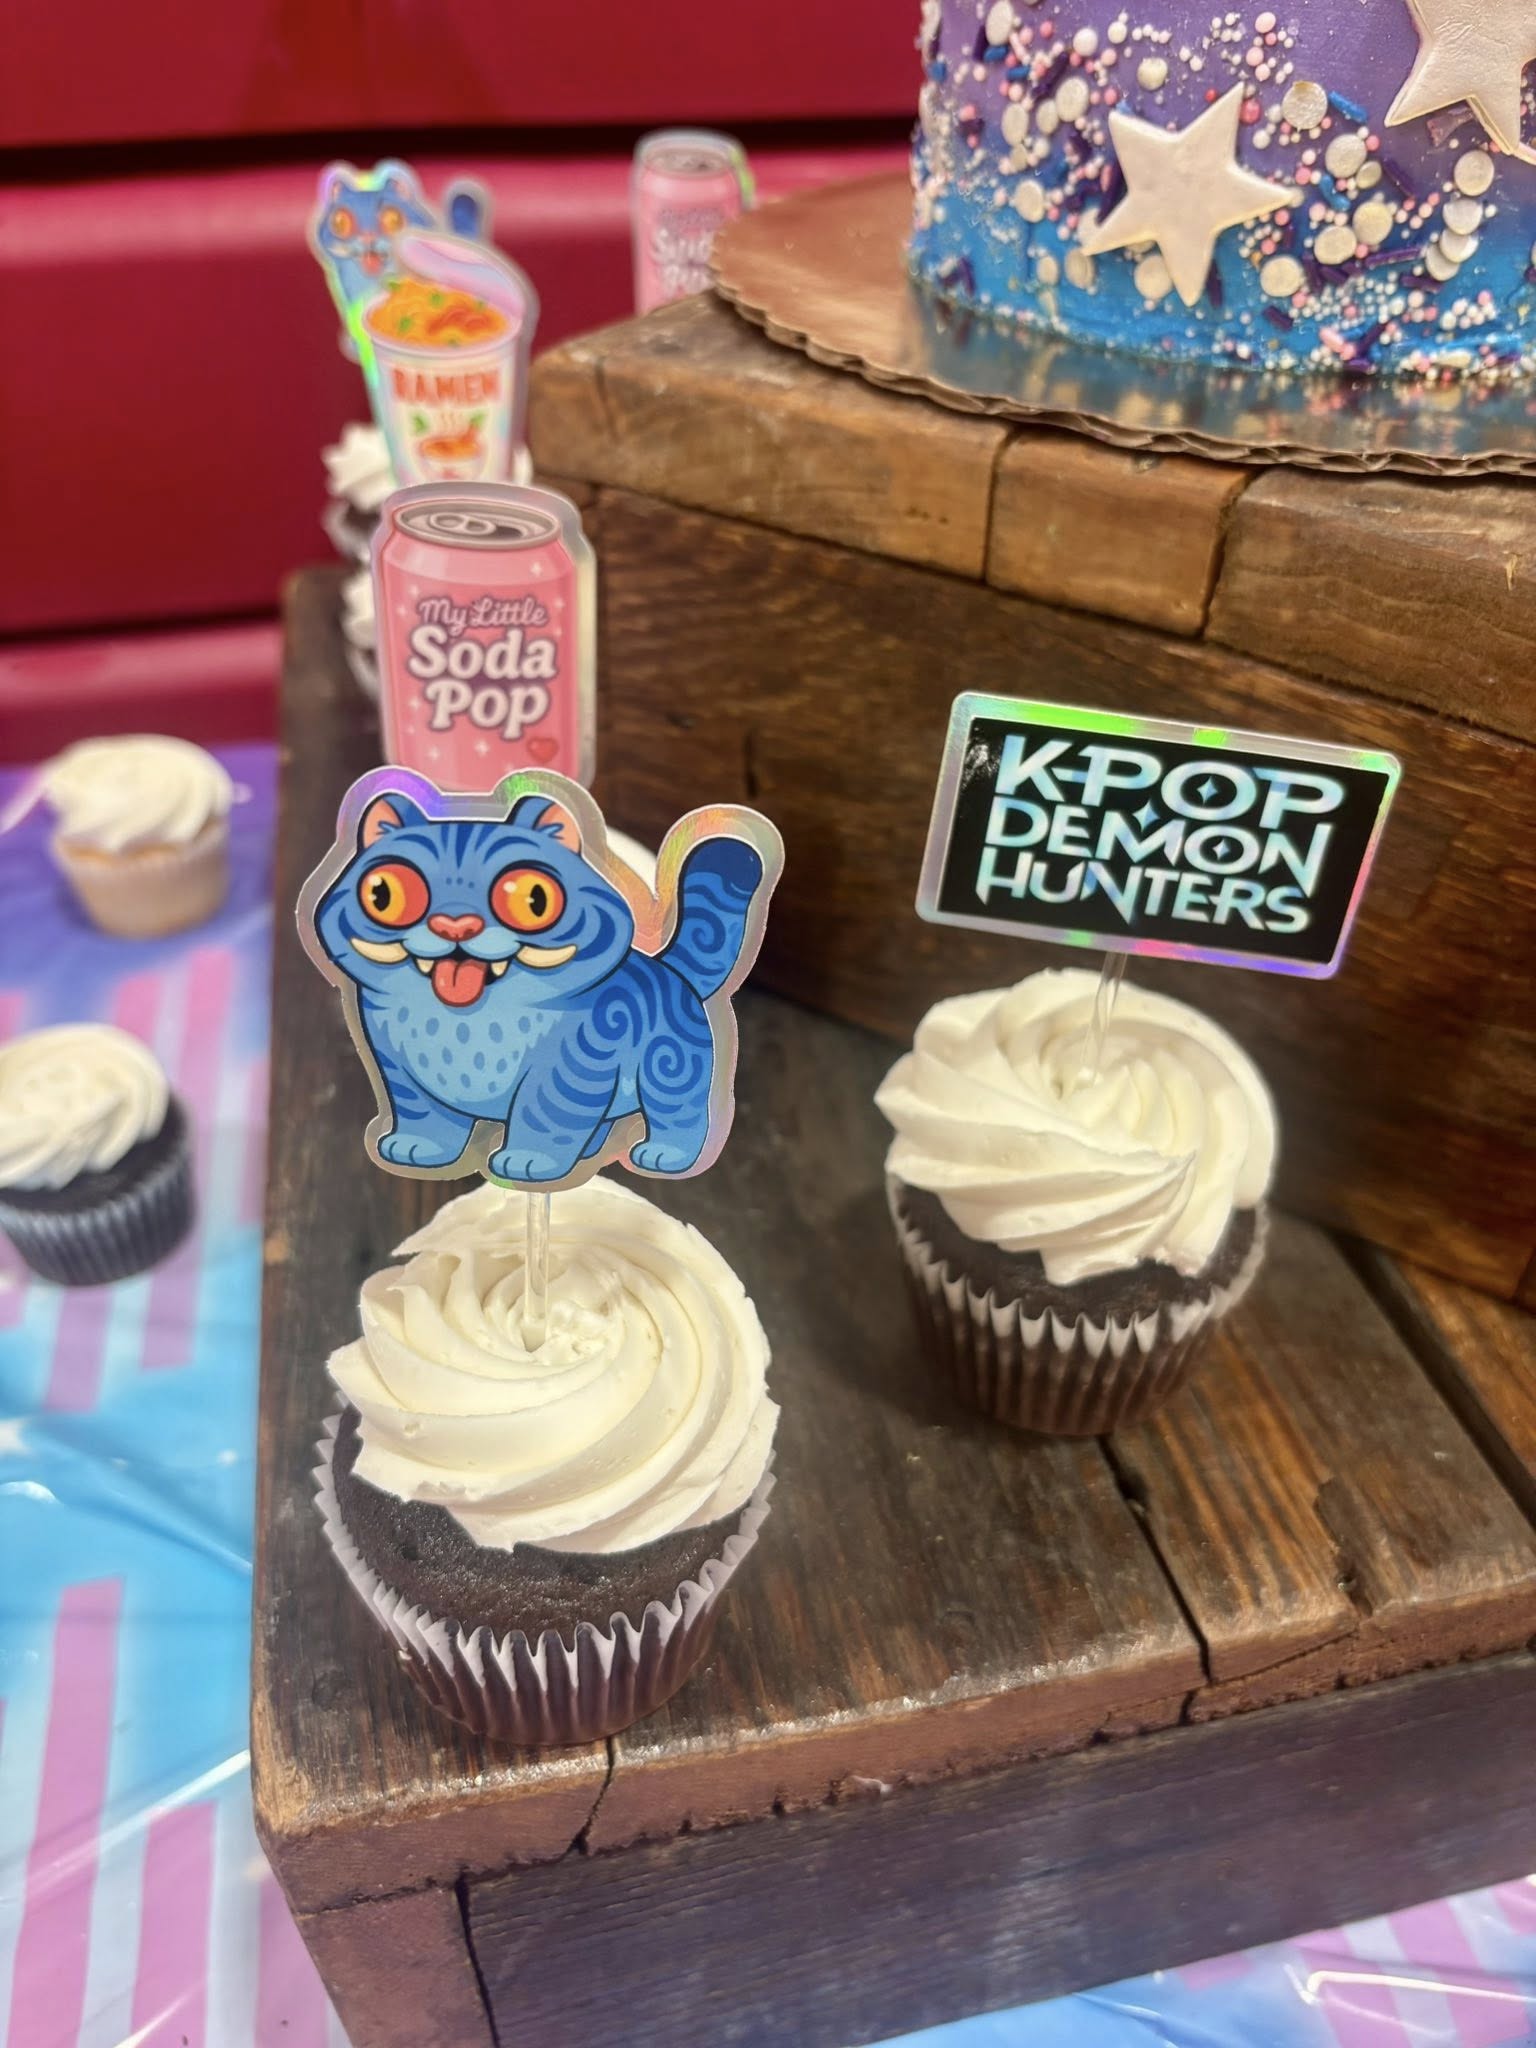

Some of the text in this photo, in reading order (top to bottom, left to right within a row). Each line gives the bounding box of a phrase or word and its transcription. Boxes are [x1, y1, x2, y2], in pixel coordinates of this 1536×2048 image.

[418, 597, 548, 637] My Little
[408, 624, 557, 680] Soda
[425, 679, 548, 740] Pop
[984, 796, 1332, 898] DEMON
[974, 846, 1309, 934] HUNTERS
